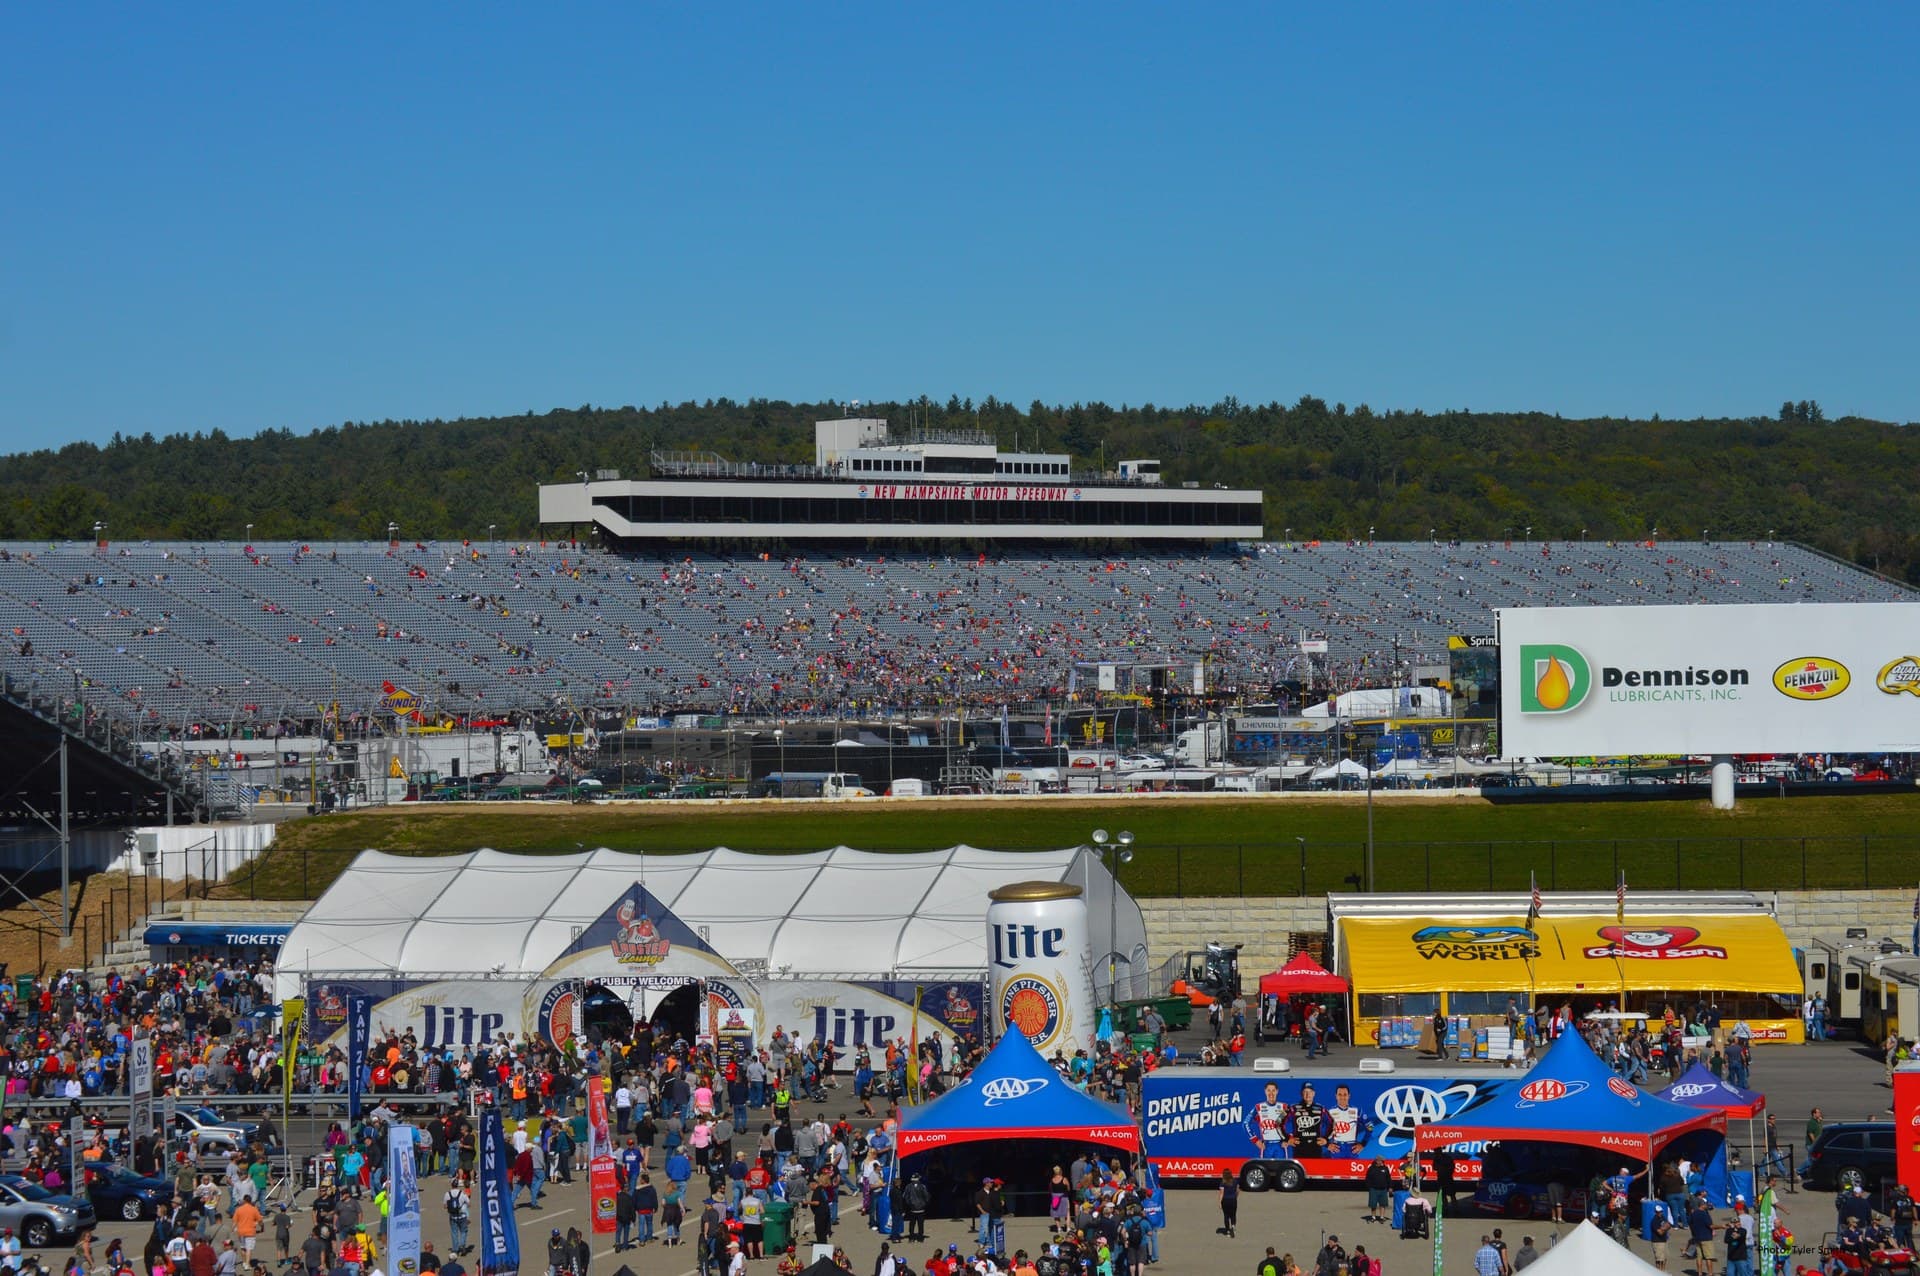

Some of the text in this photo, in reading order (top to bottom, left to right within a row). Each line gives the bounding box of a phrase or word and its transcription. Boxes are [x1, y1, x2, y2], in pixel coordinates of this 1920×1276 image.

[874, 486, 1068, 500] NEW HAMPSHIRE MOTOR SPEEDWAY
[1470, 636, 1497, 647] Sprin
[1602, 665, 1749, 688] Dennison
[1784, 668, 1840, 688] PENNZOIL
[381, 698, 423, 708] SUNOCO
[1610, 689, 1742, 703] LUBRICANTS, INC.
[1241, 721, 1288, 729] CHEVROLET
[225, 934, 286, 945] TICKETS
[992, 923, 1064, 969] Lite
[610, 940, 671, 957] LOBSTER
[1416, 942, 1540, 952] CAMPING
[1587, 946, 1724, 959] Good Sam
[618, 952, 664, 966] Lounge
[1419, 949, 1542, 961] WORLD
[600, 976, 690, 986] PUBLIC WELCOME
[544, 984, 566, 1008] FINE
[708, 981, 742, 1008] PILSNE
[1004, 983, 1022, 1008] FINE
[1019, 980, 1057, 1018] PILSNER
[355, 999, 366, 1043] FAN
[420, 1004, 504, 1053] Lite
[812, 1005, 896, 1060] Lite
[1749, 1029, 1787, 1039] ood Sam
[136, 1045, 148, 1067] S2
[990, 1080, 1025, 1098] AAA
[1521, 1080, 1564, 1101] AAA
[1673, 1084, 1701, 1096] AAA
[1147, 1091, 1241, 1117] DRIVE LIKE A
[1382, 1088, 1440, 1127] AAA
[1147, 1105, 1243, 1138] CHAMPION
[904, 1133, 947, 1144] AAA.com
[1089, 1129, 1133, 1139] AAA.com
[1421, 1130, 1463, 1140] AAA.com
[484, 1114, 496, 1170] FAN
[1600, 1135, 1643, 1148] AAA.com
[1165, 1161, 1215, 1172] AAA.com
[1350, 1162, 1365, 1172] So
[1455, 1163, 1469, 1173] So
[485, 1179, 507, 1255] ZONE
